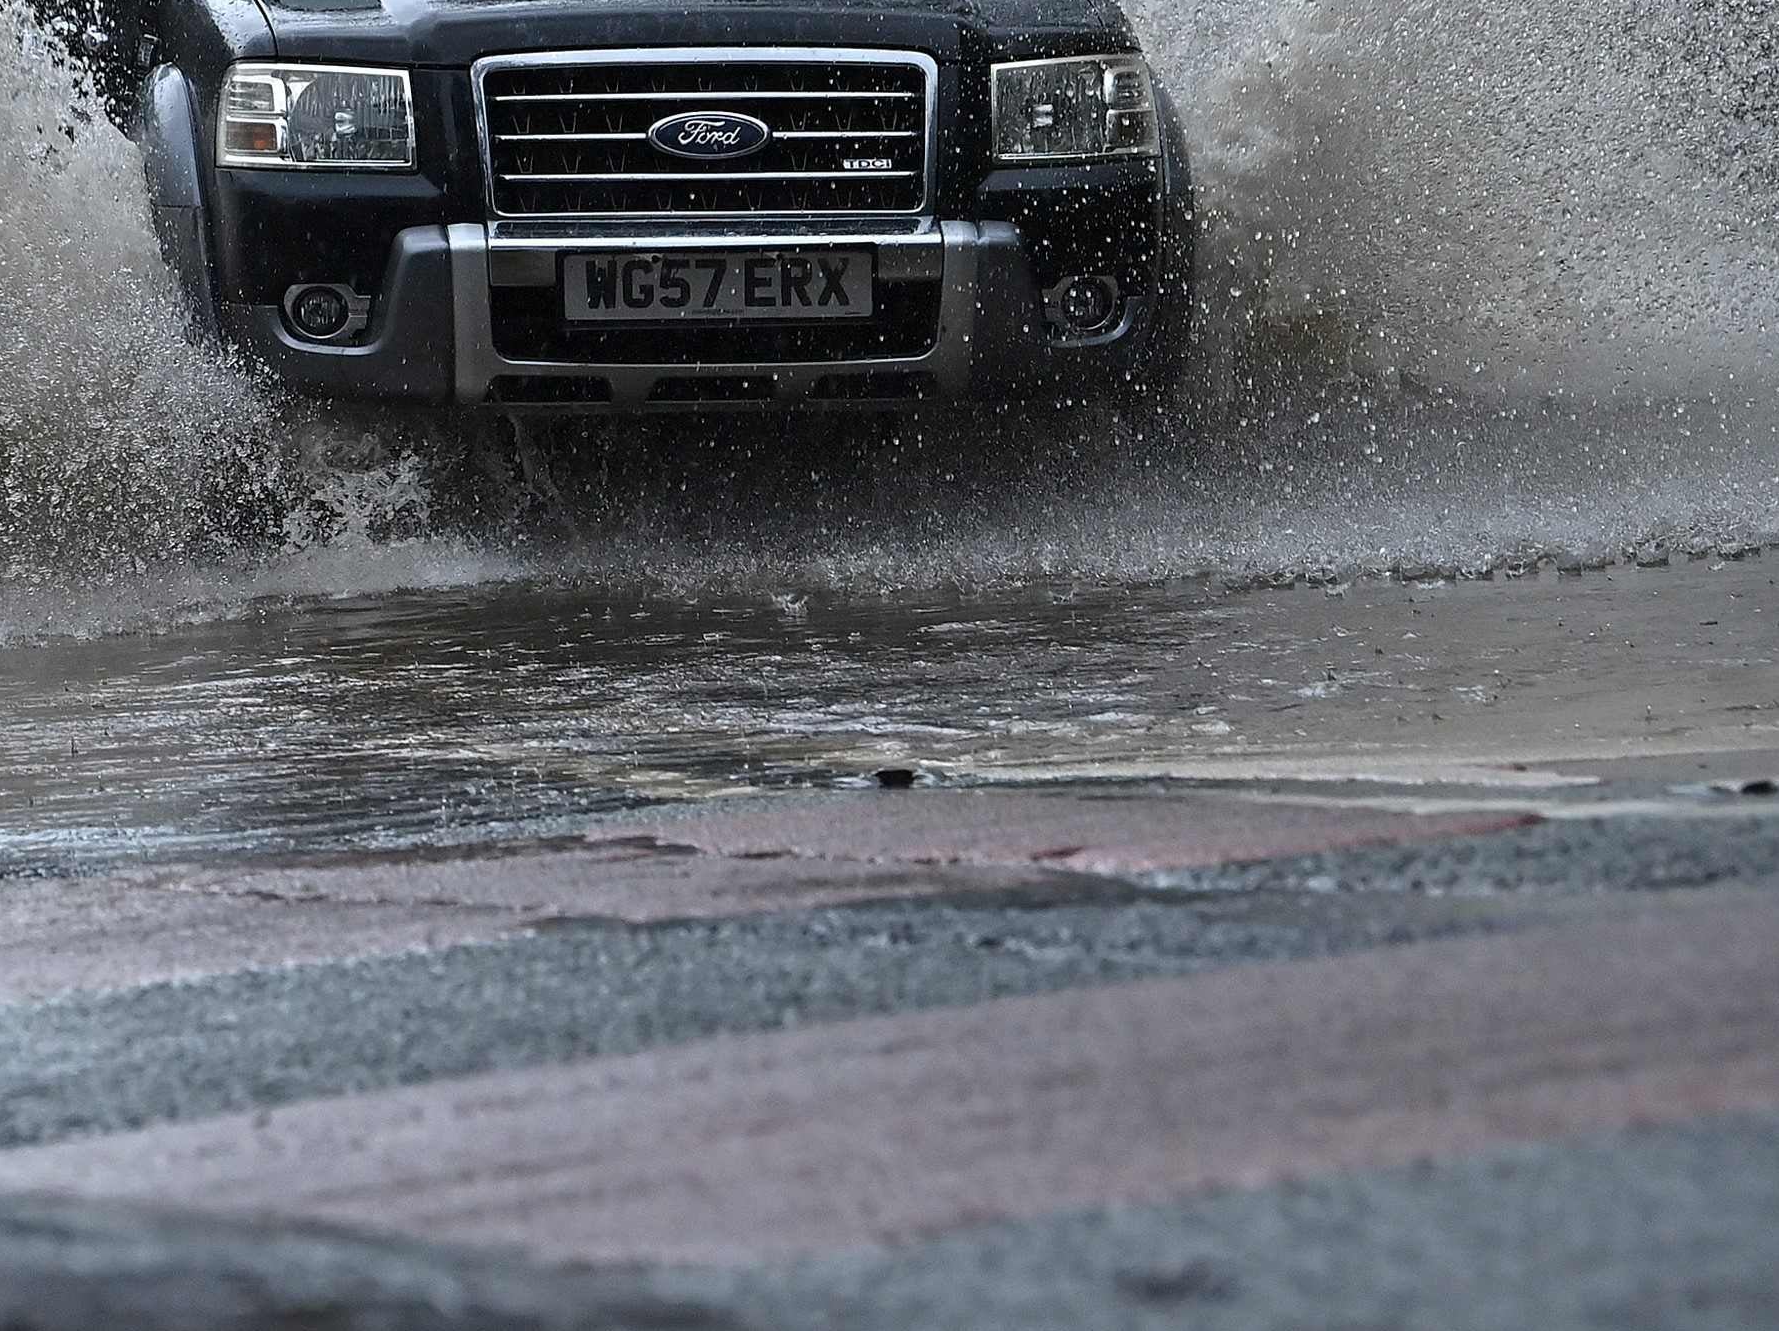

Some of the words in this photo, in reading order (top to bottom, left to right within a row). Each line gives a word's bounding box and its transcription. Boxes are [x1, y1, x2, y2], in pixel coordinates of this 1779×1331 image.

[678, 120, 741, 146] Ford
[585, 258, 727, 309] WG57
[744, 257, 851, 307] ERX
